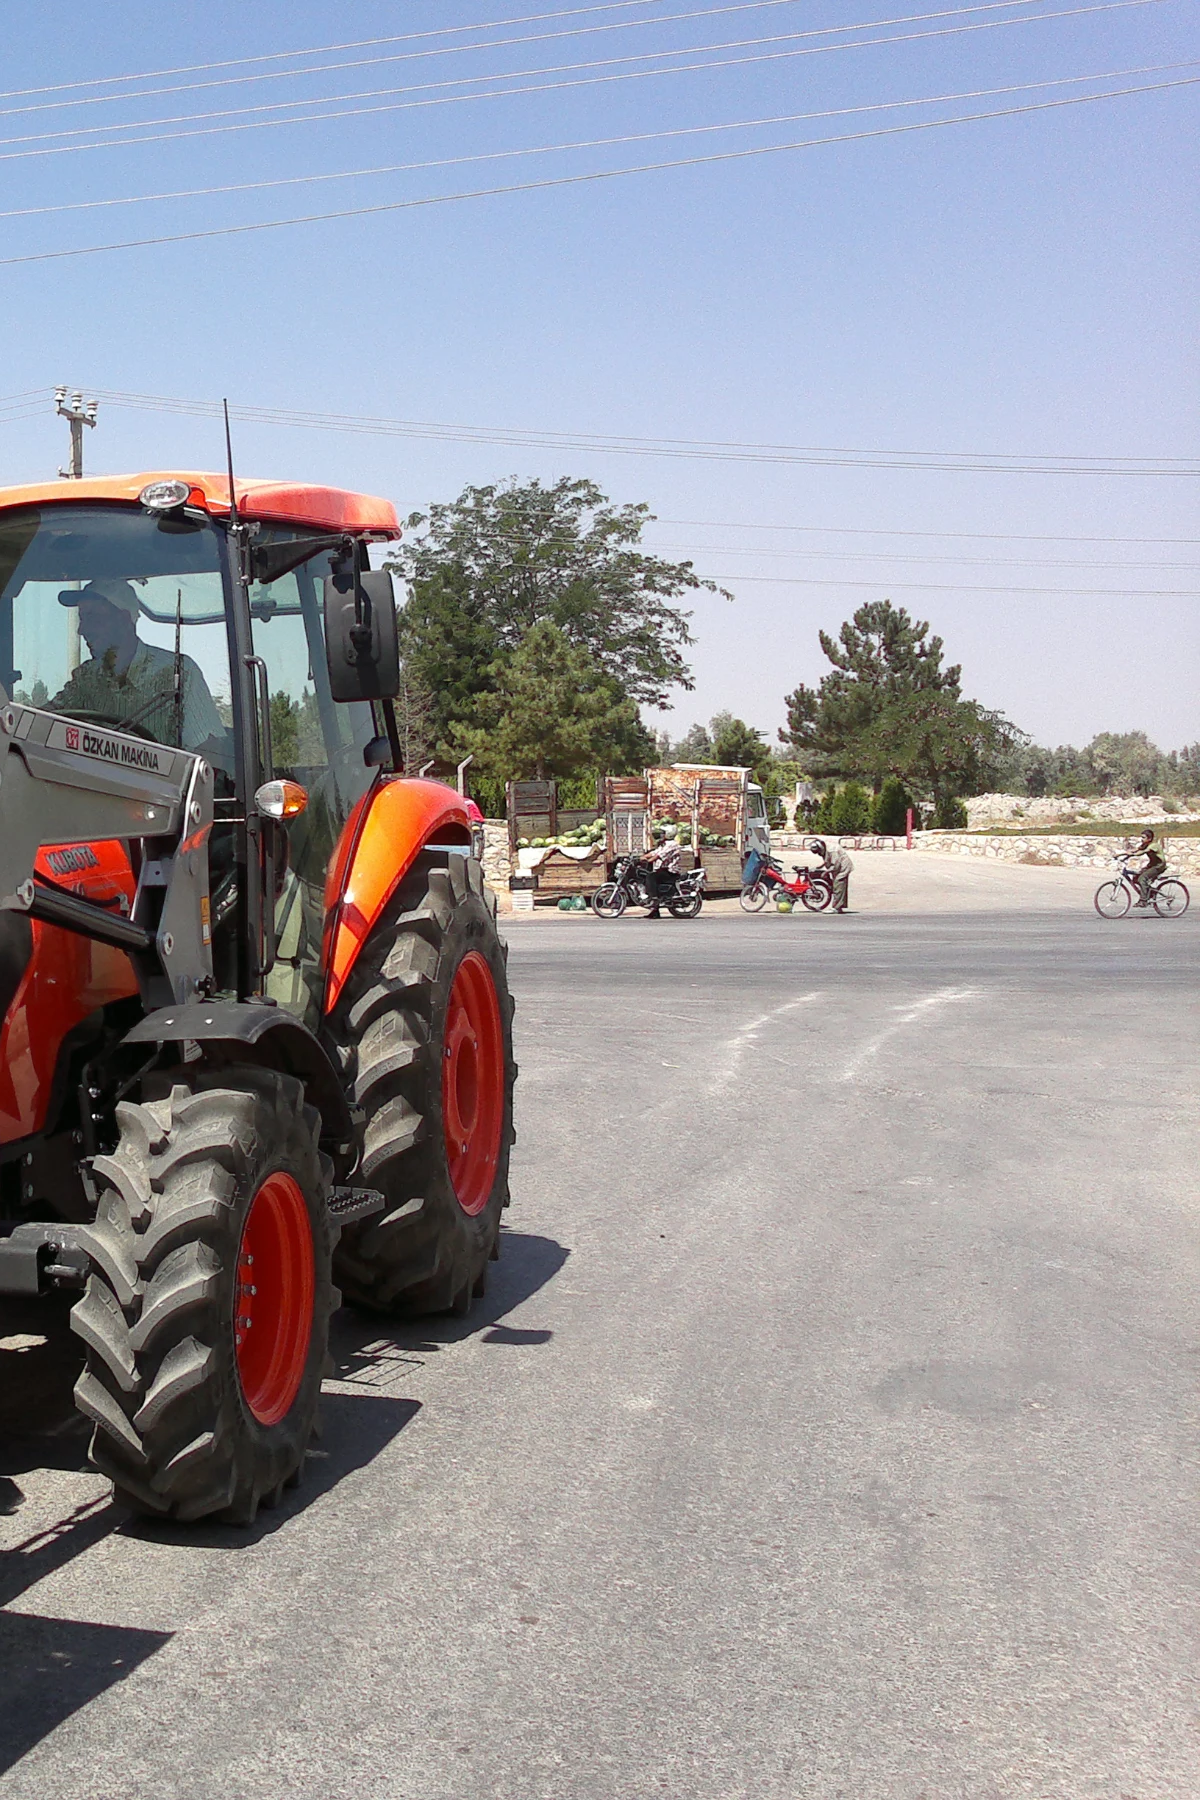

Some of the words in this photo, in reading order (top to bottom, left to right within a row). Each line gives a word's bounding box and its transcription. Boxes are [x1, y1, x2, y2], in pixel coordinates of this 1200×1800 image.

[82, 731, 119, 760] ÖZKAN
[121, 744, 159, 771] MAKİNA
[46, 846, 99, 876] KUBOTA
